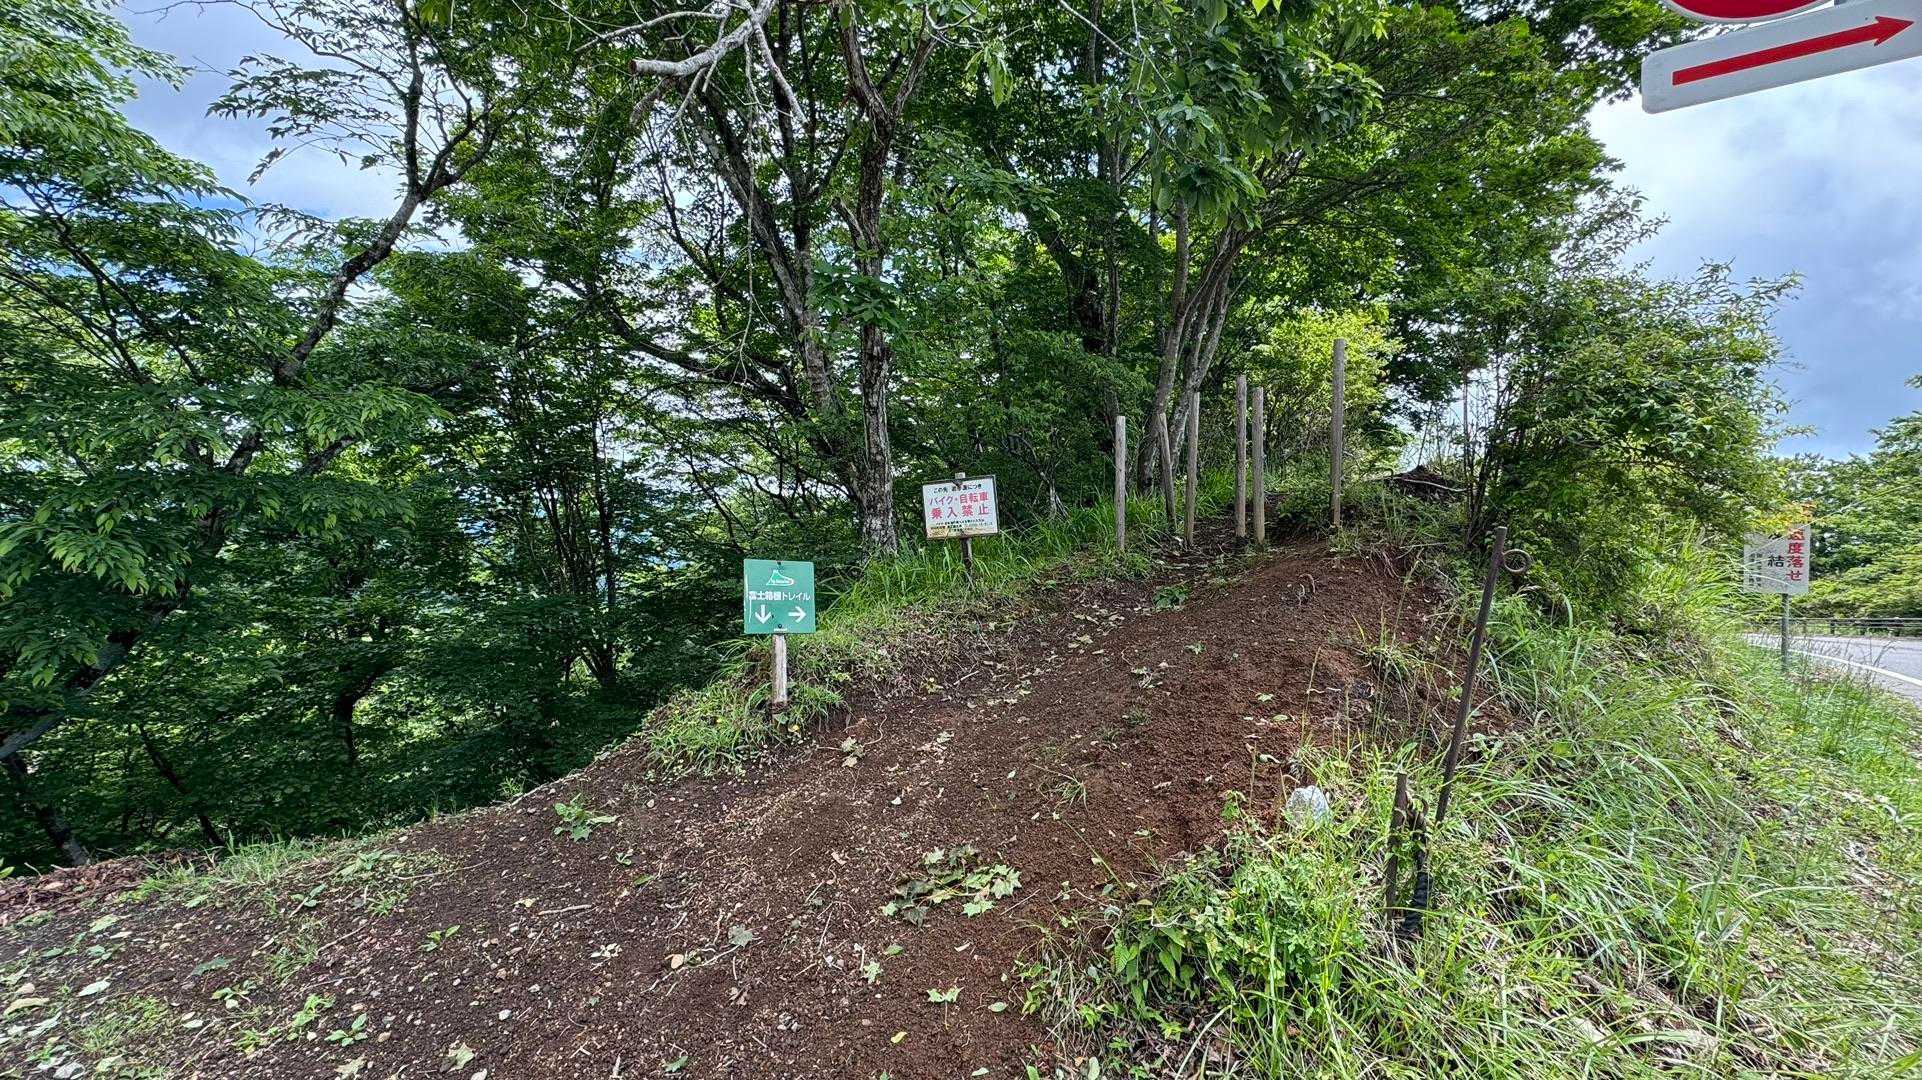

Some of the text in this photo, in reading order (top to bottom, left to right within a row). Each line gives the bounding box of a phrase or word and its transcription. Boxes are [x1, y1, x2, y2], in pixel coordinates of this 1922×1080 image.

[929, 491, 989, 506] バイク・自転車
[929, 503, 990, 520] 乗入禁止
[748, 590, 811, 601] 富士箱根トレイル
